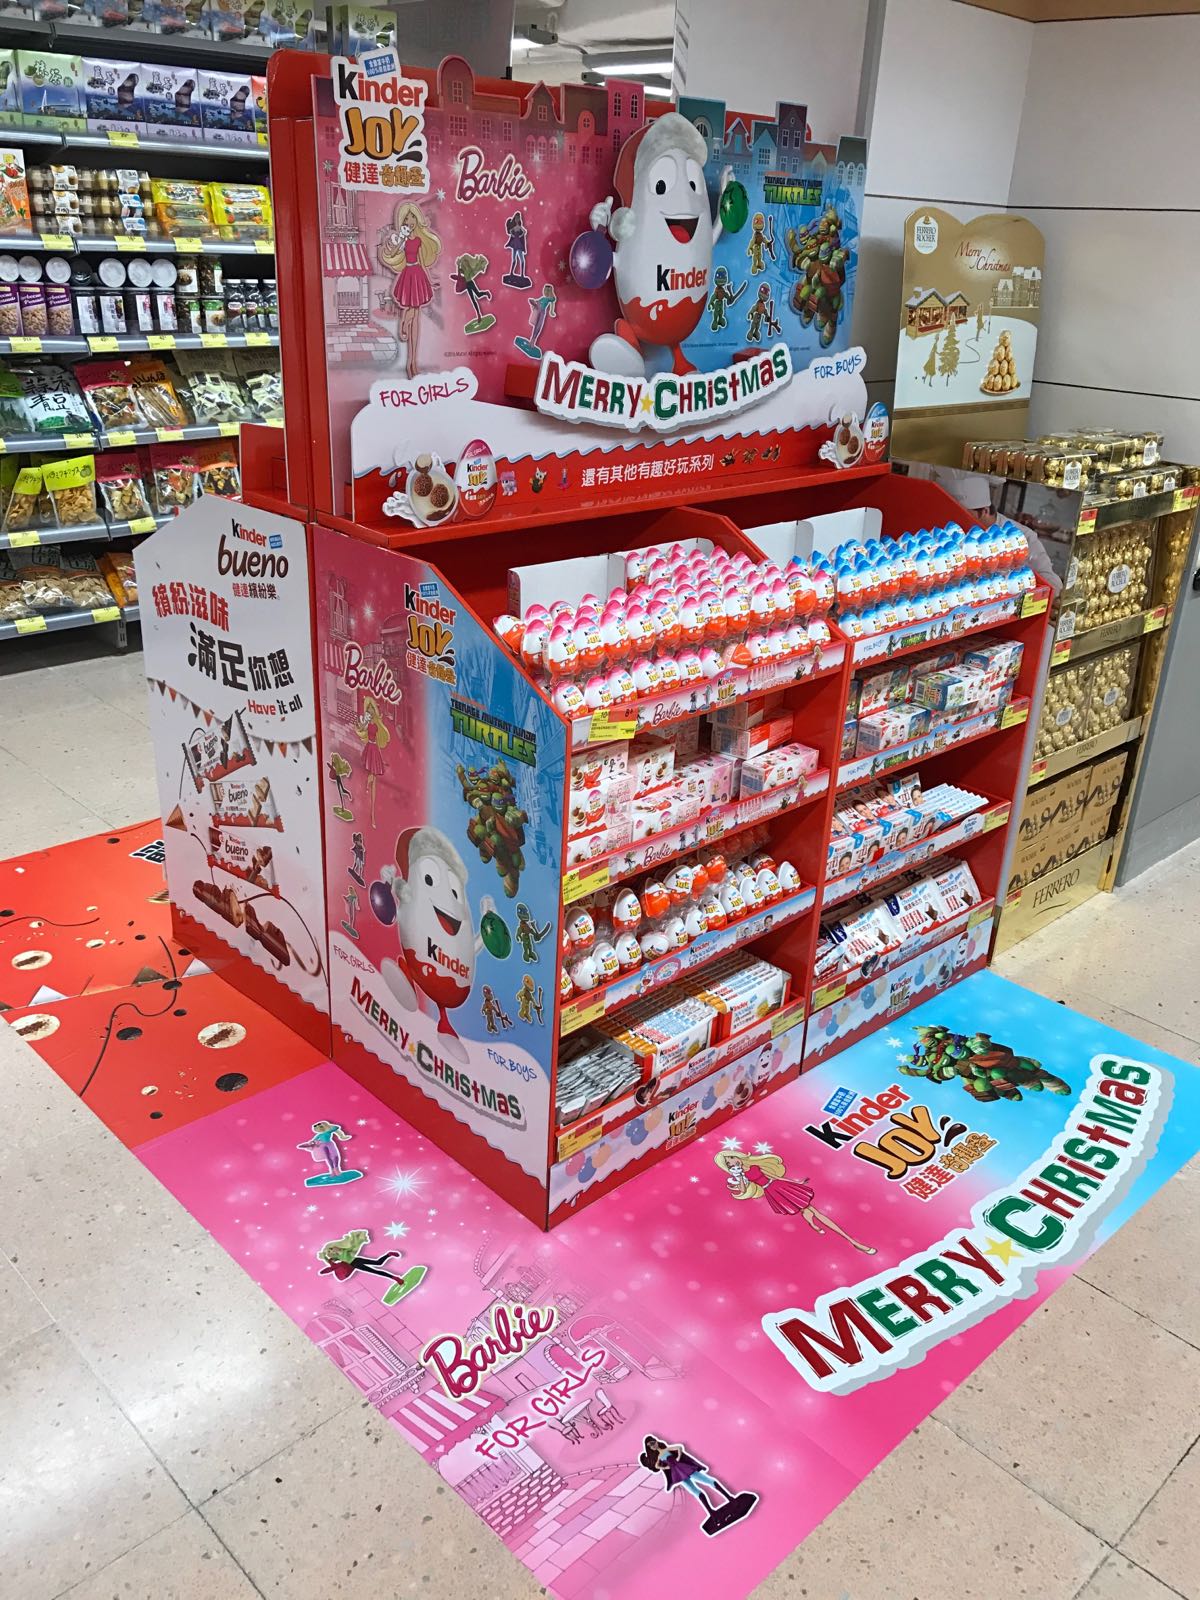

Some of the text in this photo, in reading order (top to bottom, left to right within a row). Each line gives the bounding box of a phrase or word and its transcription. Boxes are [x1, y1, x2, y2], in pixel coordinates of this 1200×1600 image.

[338, 64, 423, 107] Kinder
[457, 147, 532, 202] Barbie
[764, 184, 823, 206] TURTLES
[657, 265, 707, 291] Kinder
[813, 365, 835, 379] FOR
[379, 377, 470, 408] FOR GIRLS
[467, 464, 488, 472] Kinder
[581, 453, 715, 489] 還有其他有趣好玩系列
[231, 518, 267, 547] Kinder
[218, 534, 289, 579] bueno
[152, 582, 230, 632] 繽紛滋味
[405, 583, 456, 626] Kinder
[188, 622, 294, 691] 滿足你想
[344, 642, 402, 704] Barbie
[717, 676, 737, 687] Kinder
[247, 694, 303, 716] Have it all
[651, 702, 684, 726] Barbie
[203, 735, 219, 753] bueno
[450, 707, 537, 769] TURTLES
[228, 788, 249, 803] bueno
[225, 840, 249, 856] bueno
[643, 845, 673, 869] Barbie
[1032, 868, 1080, 908] FERRERO
[333, 944, 375, 974] FOR GIRLS
[427, 936, 470, 979] Kinder
[689, 941, 710, 955] Kinder
[890, 976, 913, 993] Kinder
[487, 1048, 508, 1071] FOR
[660, 1043, 679, 1056] Kinder
[689, 1055, 706, 1069] Kinder
[668, 1100, 699, 1123] Kinder
[805, 1084, 911, 1149] Kinder
[854, 1106, 941, 1179] JOY
[422, 1305, 555, 1398] Barbie
[475, 1347, 607, 1461] FOR GIRLS
